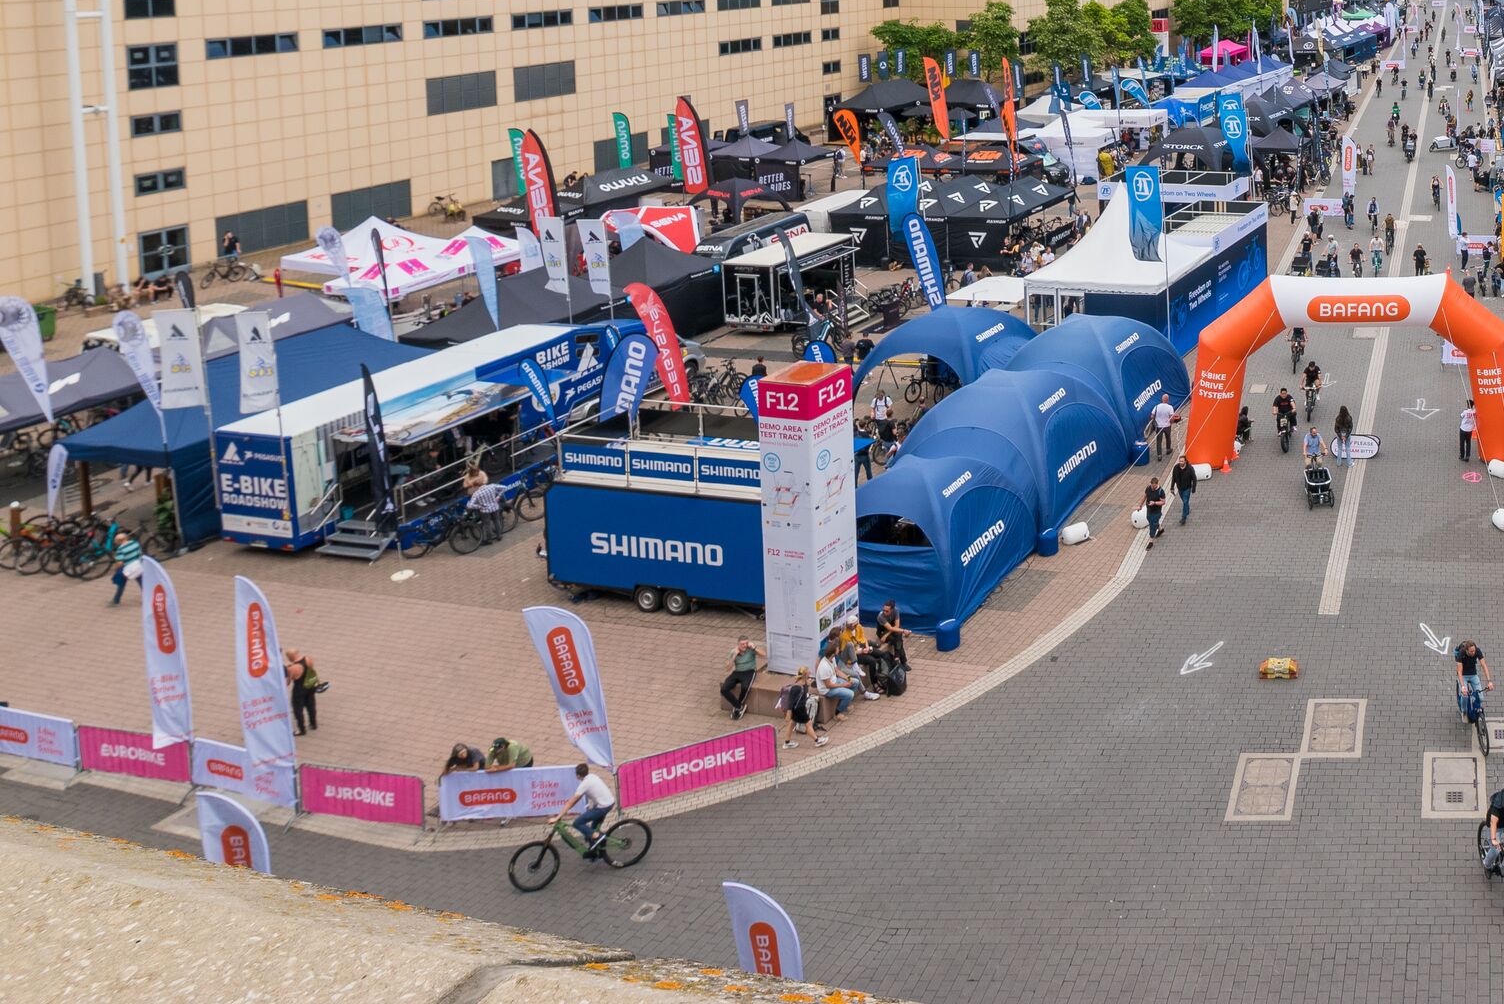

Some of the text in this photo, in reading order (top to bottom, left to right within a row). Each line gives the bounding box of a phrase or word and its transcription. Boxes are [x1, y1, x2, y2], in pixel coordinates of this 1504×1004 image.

[968, 151, 1002, 160] KTM
[599, 174, 648, 192] owuru
[759, 173, 783, 184] BETTER
[650, 212, 688, 228] SENA
[1189, 282, 1206, 300] Freedom
[1319, 302, 1399, 317] BAFANG
[976, 323, 1005, 343] SHIMANO
[1115, 332, 1139, 354] SHIMANO
[1201, 370, 1226, 381] E-BIKE
[1477, 368, 1501, 376] E-BIKE
[1200, 380, 1224, 389] DRIVE
[1478, 378, 1501, 386] DRIVE
[766, 391, 799, 411] F12
[818, 379, 845, 407] F12
[1039, 387, 1066, 414] SHIMANO
[1134, 379, 1162, 411] SHIMANO
[1199, 389, 1234, 399] SYSTEMS
[813, 409, 848, 431] DEMO AREA
[779, 433, 803, 441] TRACK
[783, 425, 802, 433] AREA
[813, 428, 827, 440] TEST
[829, 418, 848, 430] TRACK
[565, 452, 622, 467] SHIMANO
[632, 459, 691, 474] SHIMANO
[1057, 440, 1097, 482] SHIMANO
[701, 465, 760, 479] SHIMANO
[221, 473, 286, 497] E-BIKE
[942, 471, 972, 498] SHIMANO
[222, 493, 287, 510] ROADSHOW
[591, 532, 723, 566] SHIMANO
[960, 520, 1005, 566] SHIMANO
[768, 548, 780, 556] F12
[553, 634, 579, 689] BAFANG
[243, 696, 274, 710] E-Bike
[243, 705, 273, 719] Drive
[246, 711, 288, 729] Systems
[566, 709, 594, 720] E-Bike
[567, 718, 593, 730] Drive
[571, 723, 607, 740] Systems
[101, 743, 165, 766] EUROBIKE
[651, 747, 745, 784] EUROBIKE
[531, 780, 559, 790] E-Bike
[325, 785, 395, 806] EUROBIKE
[464, 791, 511, 803] BAFANG
[531, 790, 556, 799] Drive
